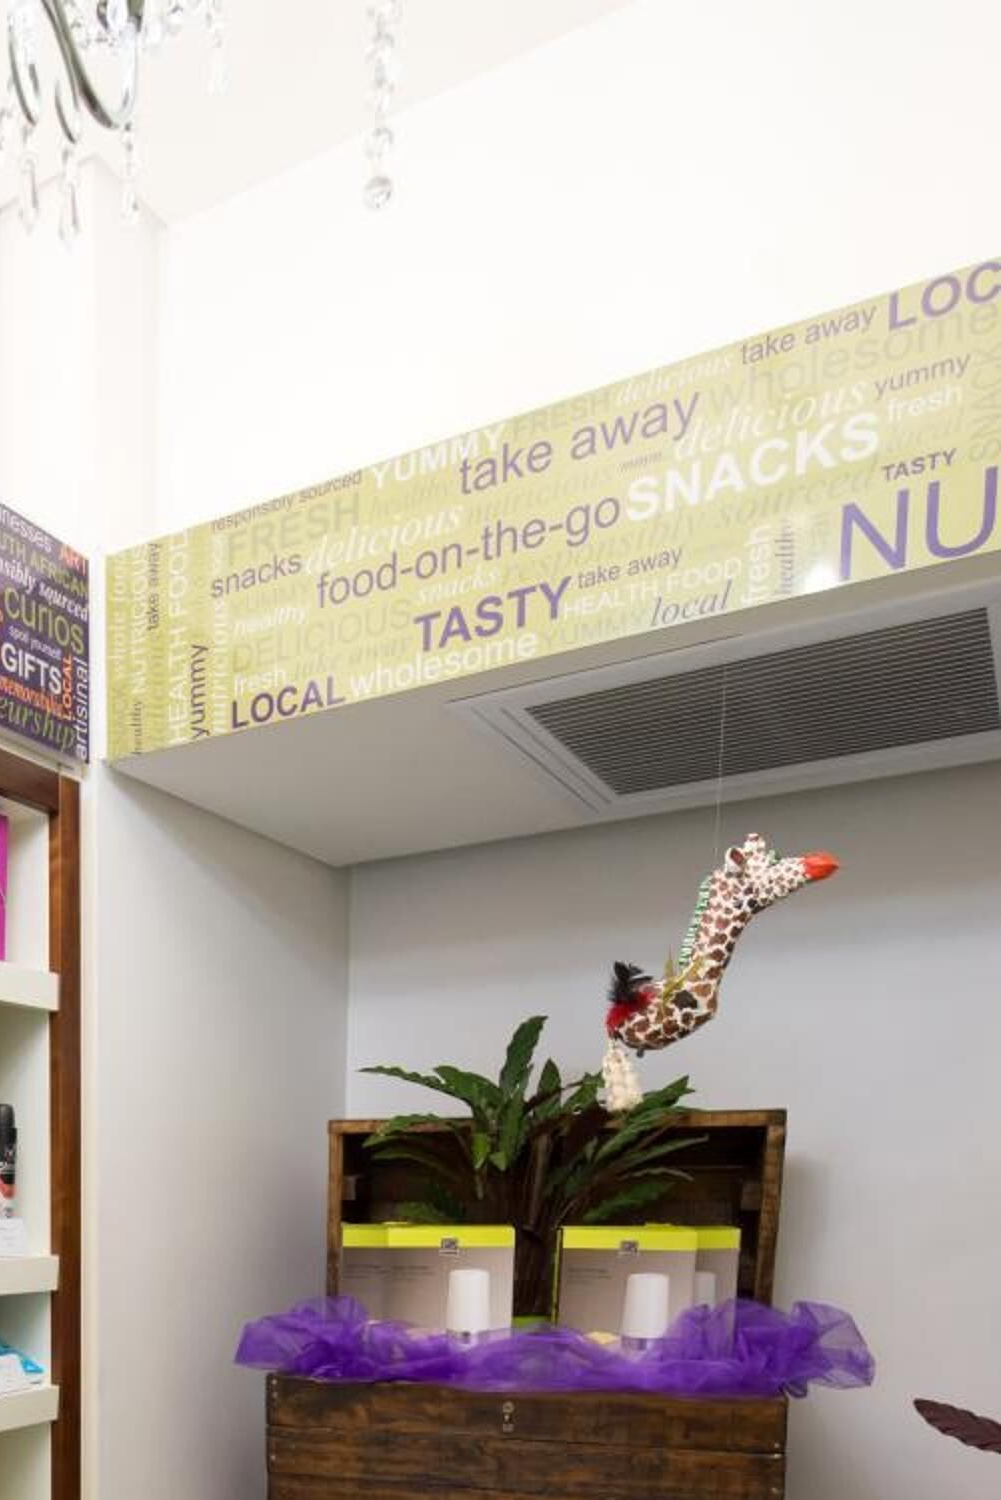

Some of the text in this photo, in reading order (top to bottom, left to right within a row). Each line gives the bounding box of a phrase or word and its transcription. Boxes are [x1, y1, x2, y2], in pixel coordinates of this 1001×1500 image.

[742, 304, 878, 366] take away
[874, 353, 971, 400] yummy
[460, 392, 700, 495] take away
[626, 410, 880, 523] SNACKS
[881, 448, 958, 482] TASTY
[211, 553, 302, 599] snacks
[316, 496, 621, 609] food-on-the-go
[578, 546, 683, 590] take away
[3, 586, 85, 655] curios
[413, 575, 572, 652] TASTY
[650, 578, 733, 627] local
[1, 642, 62, 695] GIFTS
[189, 643, 210, 740] yummy
[351, 632, 539, 699] wholesome
[231, 675, 346, 729] LOCAL
